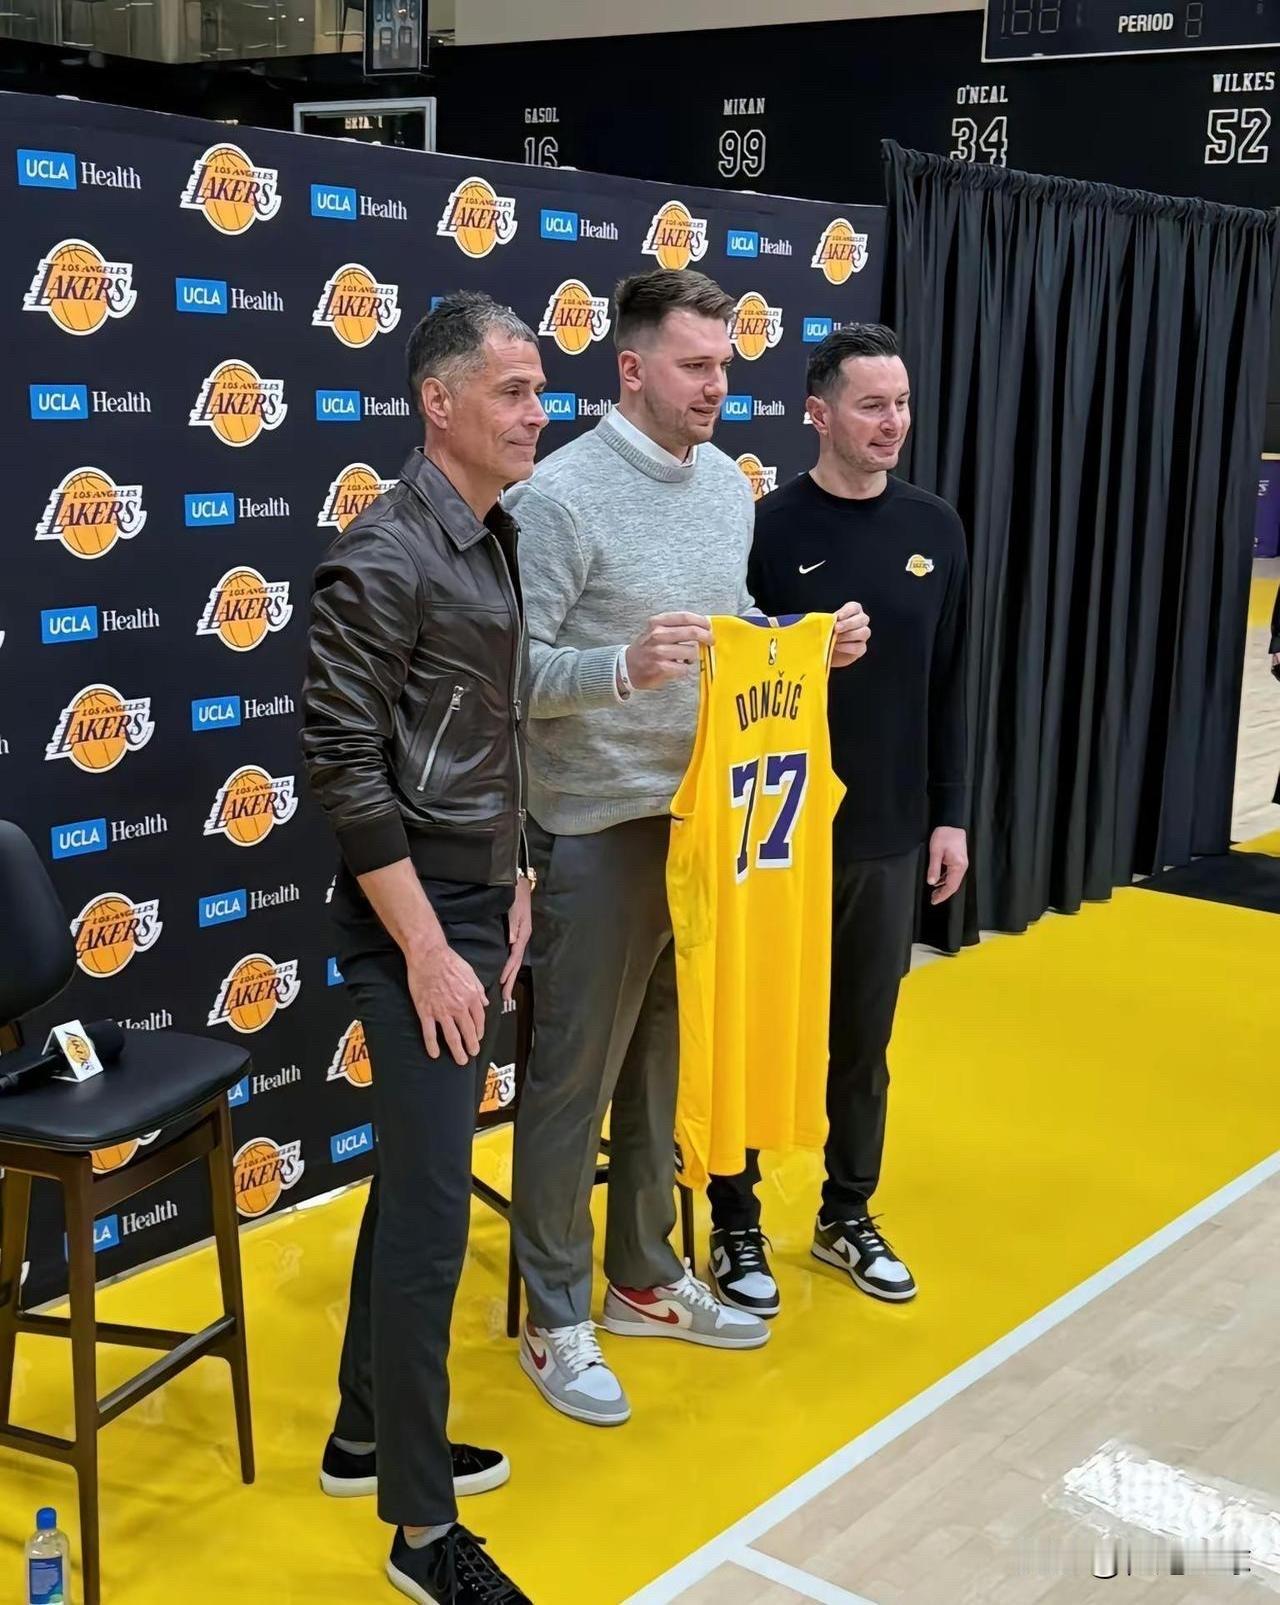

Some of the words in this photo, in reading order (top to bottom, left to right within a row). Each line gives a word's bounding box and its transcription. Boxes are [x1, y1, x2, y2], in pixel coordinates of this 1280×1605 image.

[1118, 13, 1174, 33] PERIOD
[957, 85, 1008, 104] O'NEAL
[1213, 72, 1275, 93] WILKES
[525, 107, 559, 123] GASOL
[723, 97, 765, 115] MIKAN
[950, 117, 1007, 167] 34
[1205, 107, 1271, 164] 52
[525, 137, 558, 167] 16
[719, 129, 766, 177] 99
[26, 158, 69, 180] UCLA
[81, 161, 141, 189] Health
[215, 165, 232, 175] LOS
[234, 167, 274, 181] ANGELES
[190, 165, 272, 216] LAKERS
[465, 197, 478, 205] LOS
[480, 199, 512, 208] ANGELES
[317, 193, 351, 211] UCLA
[360, 195, 408, 220] Health
[446, 196, 511, 240] LAKERS
[546, 217, 573, 233] UCLA
[580, 218, 618, 240] Health
[649, 218, 704, 257] LAKERS
[731, 236, 754, 251] UCLA
[759, 237, 792, 256] Health
[817, 235, 864, 269] LAKERS
[61, 264, 80, 273] LOS
[82, 266, 128, 275] ANGELES
[33, 263, 127, 312] LAKERS
[183, 286, 221, 305] UCLA
[230, 287, 284, 312] Health
[359, 287, 394, 296] ANGELES
[318, 284, 394, 328] LAKERS
[547, 298, 604, 336] LAKERS
[730, 307, 778, 344] LAKERS
[807, 323, 828, 336] UCLA
[223, 382, 239, 390] LOS
[241, 383, 279, 391] ANGELES
[39, 393, 81, 411] UCLA
[92, 391, 151, 412] Health
[199, 381, 279, 425] LAKERS
[322, 398, 355, 414] UCLA
[363, 396, 410, 416] Health
[544, 399, 571, 414] UCLA
[726, 402, 748, 414] UCLA
[753, 400, 785, 416] Health
[74, 492, 92, 500] LOS
[94, 490, 138, 499] ANGELES
[751, 477, 773, 497] ERS
[45, 491, 138, 533] LAKERS
[192, 501, 229, 518] UCLA
[238, 497, 290, 518] Health
[323, 484, 378, 521] LAKE
[230, 588, 245, 597] LOS
[247, 586, 285, 595] ANGELES
[50, 614, 91, 635] UCLA
[102, 607, 160, 631] Health
[207, 590, 285, 629] LAKERS
[82, 708, 100, 716] LOS
[102, 702, 146, 714] ANGELES
[199, 704, 235, 722] UCLA
[244, 695, 294, 719] Health
[736, 672, 806, 731] DONČIĆ
[58, 711, 145, 753] LAKERS
[236, 786, 251, 795] LOS
[253, 780, 290, 792] ANGELES
[218, 790, 289, 829] LAKERS
[729, 749, 809, 885] 77
[60, 827, 101, 849] UCLA
[111, 813, 168, 842] Health
[93, 914, 110, 925] LOS
[113, 904, 154, 920] ANGELES
[205, 898, 241, 919] UCLA
[250, 883, 300, 910] Health
[76, 914, 153, 959] LAKERS
[216, 973, 292, 1018] LAKERS
[227, 1082, 243, 1100] LA
[253, 1065, 301, 1095] Health
[336, 1132, 368, 1154] UCLA
[237, 1154, 295, 1192] AKERS
[94, 1225, 111, 1244] LA
[122, 1200, 178, 1236] Health
